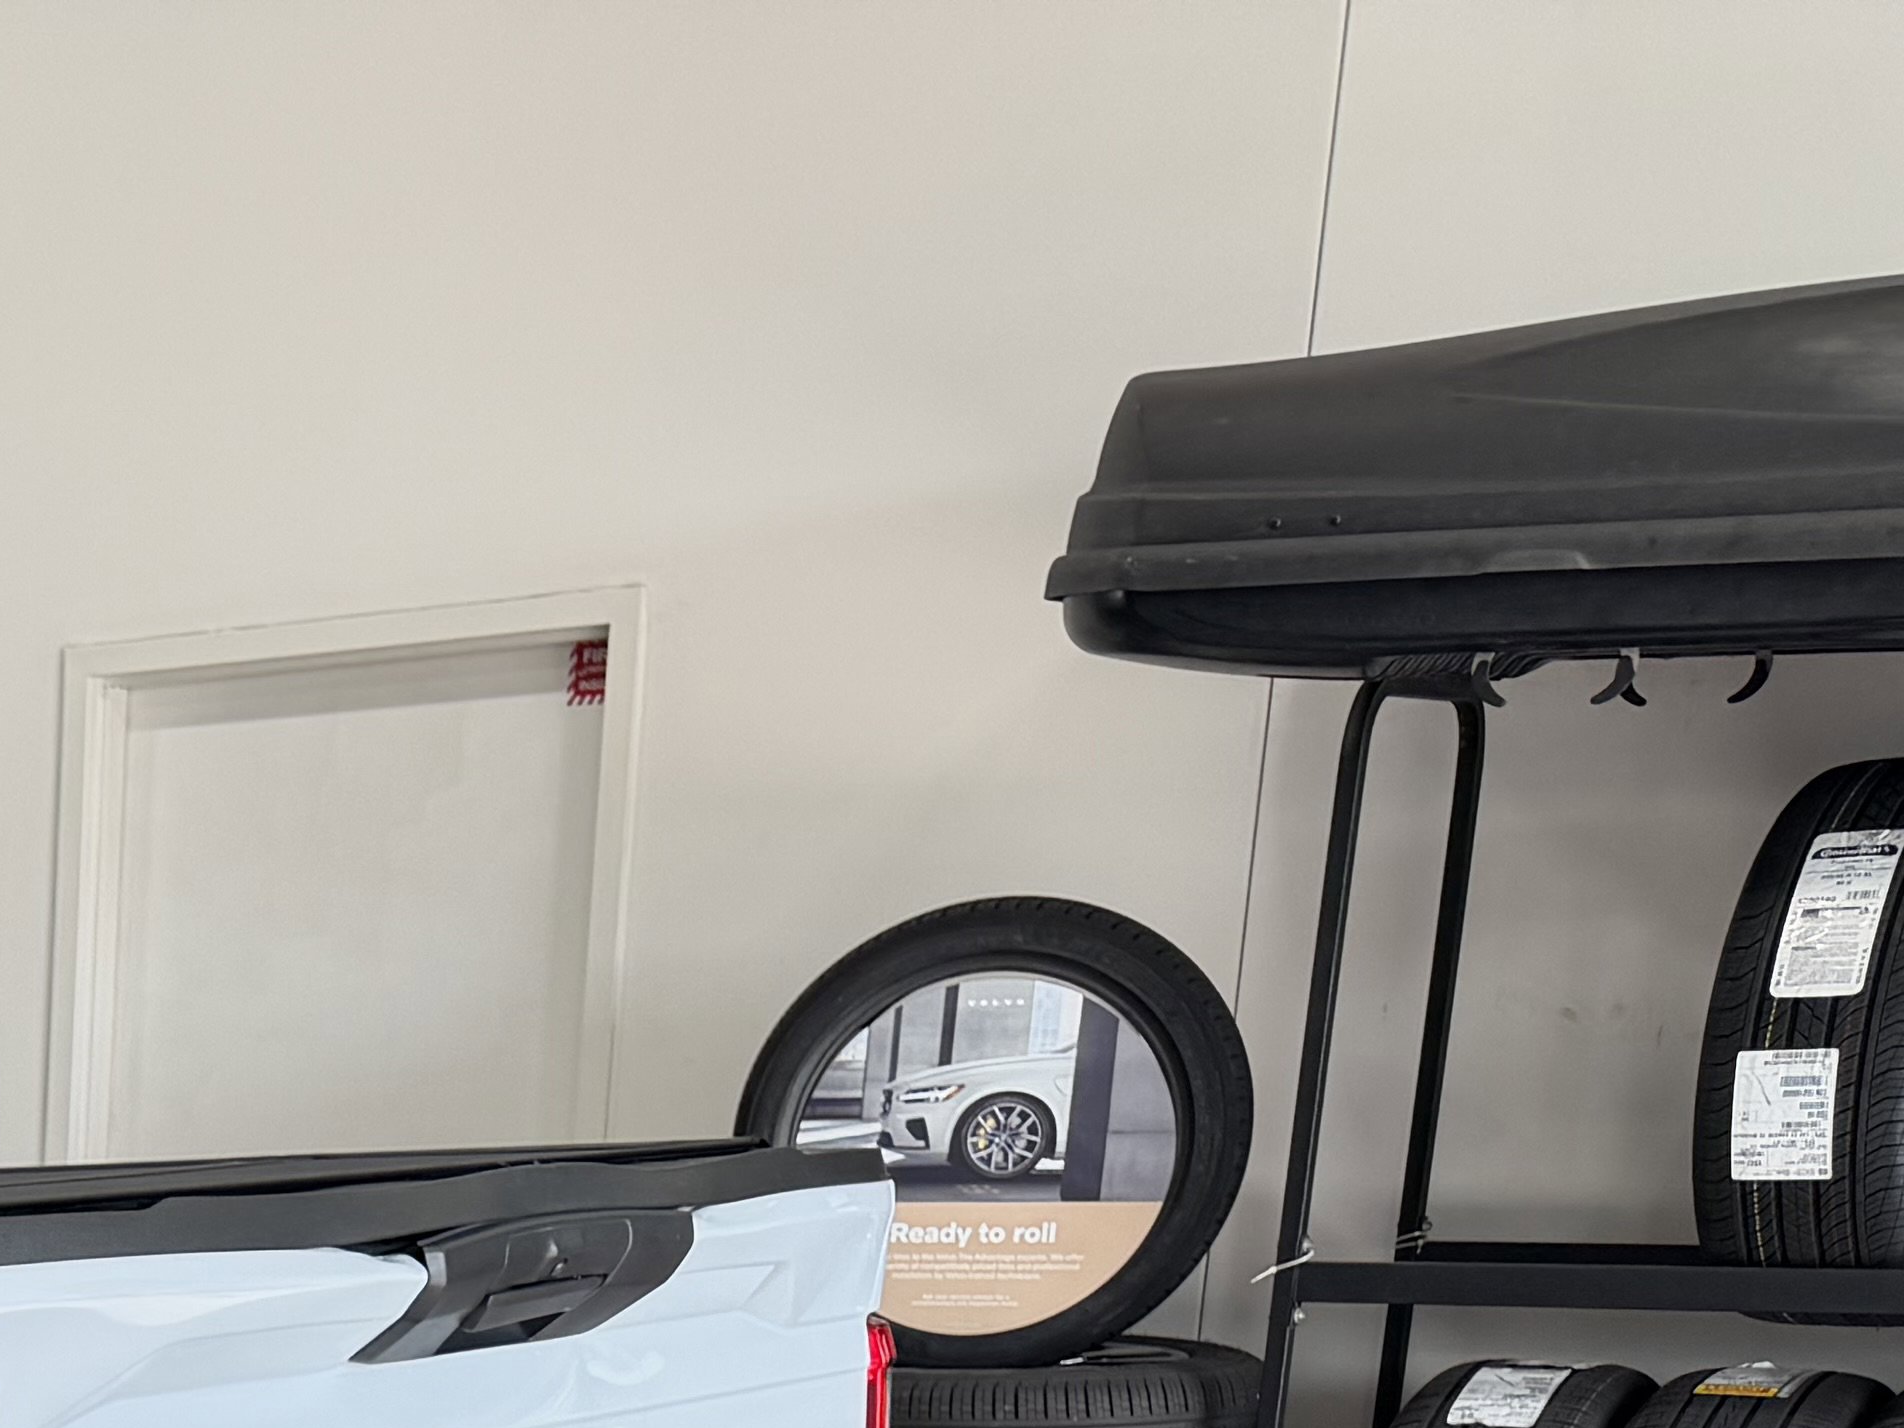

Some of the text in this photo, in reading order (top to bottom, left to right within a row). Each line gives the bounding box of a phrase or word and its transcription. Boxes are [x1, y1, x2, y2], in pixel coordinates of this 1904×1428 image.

[890, 1222, 1057, 1248] Ready to roll
